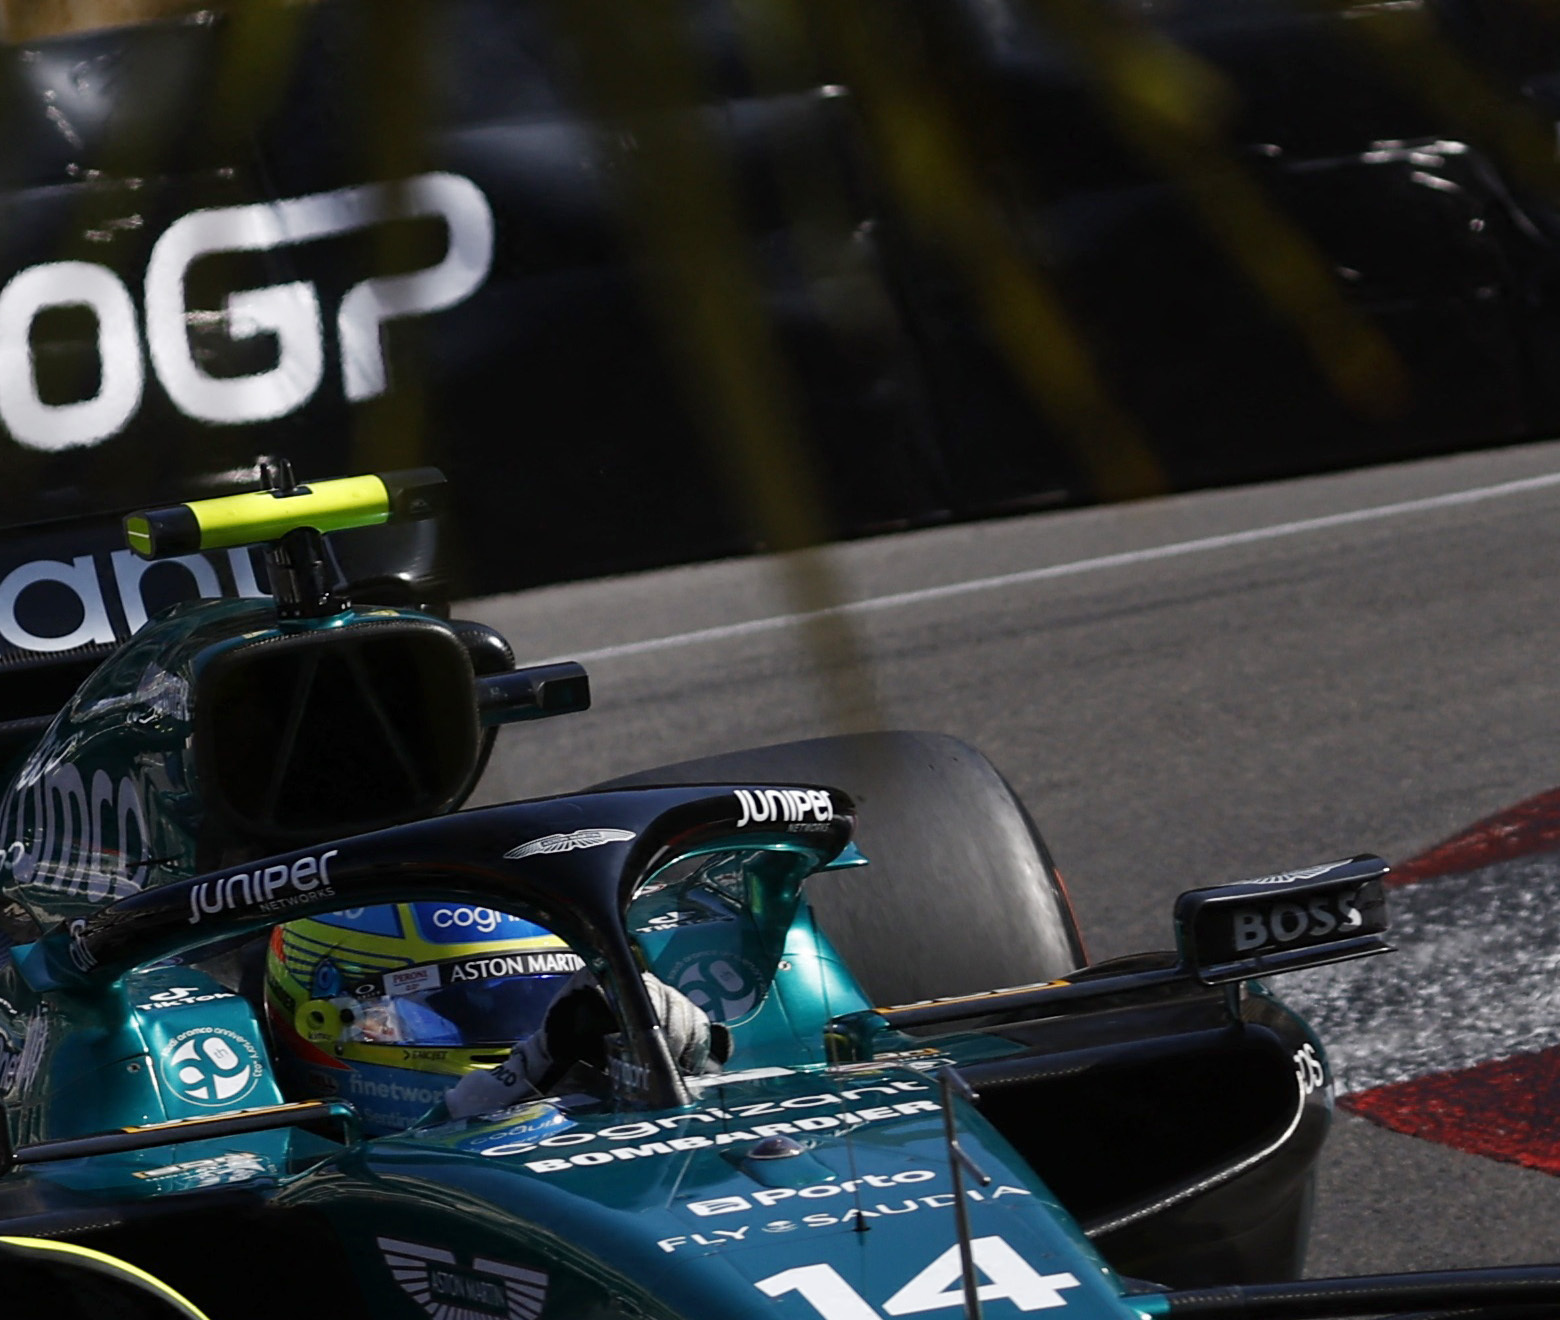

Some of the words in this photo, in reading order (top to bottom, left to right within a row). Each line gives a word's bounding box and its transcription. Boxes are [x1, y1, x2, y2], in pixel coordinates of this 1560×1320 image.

[258, 886, 336, 913] NETWORKS
[1233, 889, 1363, 951] BOSS
[449, 957, 524, 983] ASTON
[350, 1074, 449, 1104] finetwor
[480, 1080, 930, 1158] cognizant
[525, 1100, 943, 1173] BOMBARDIER
[751, 1169, 937, 1207] Porto
[656, 1226, 750, 1253] FLY
[801, 1185, 1032, 1228] SAUDIA
